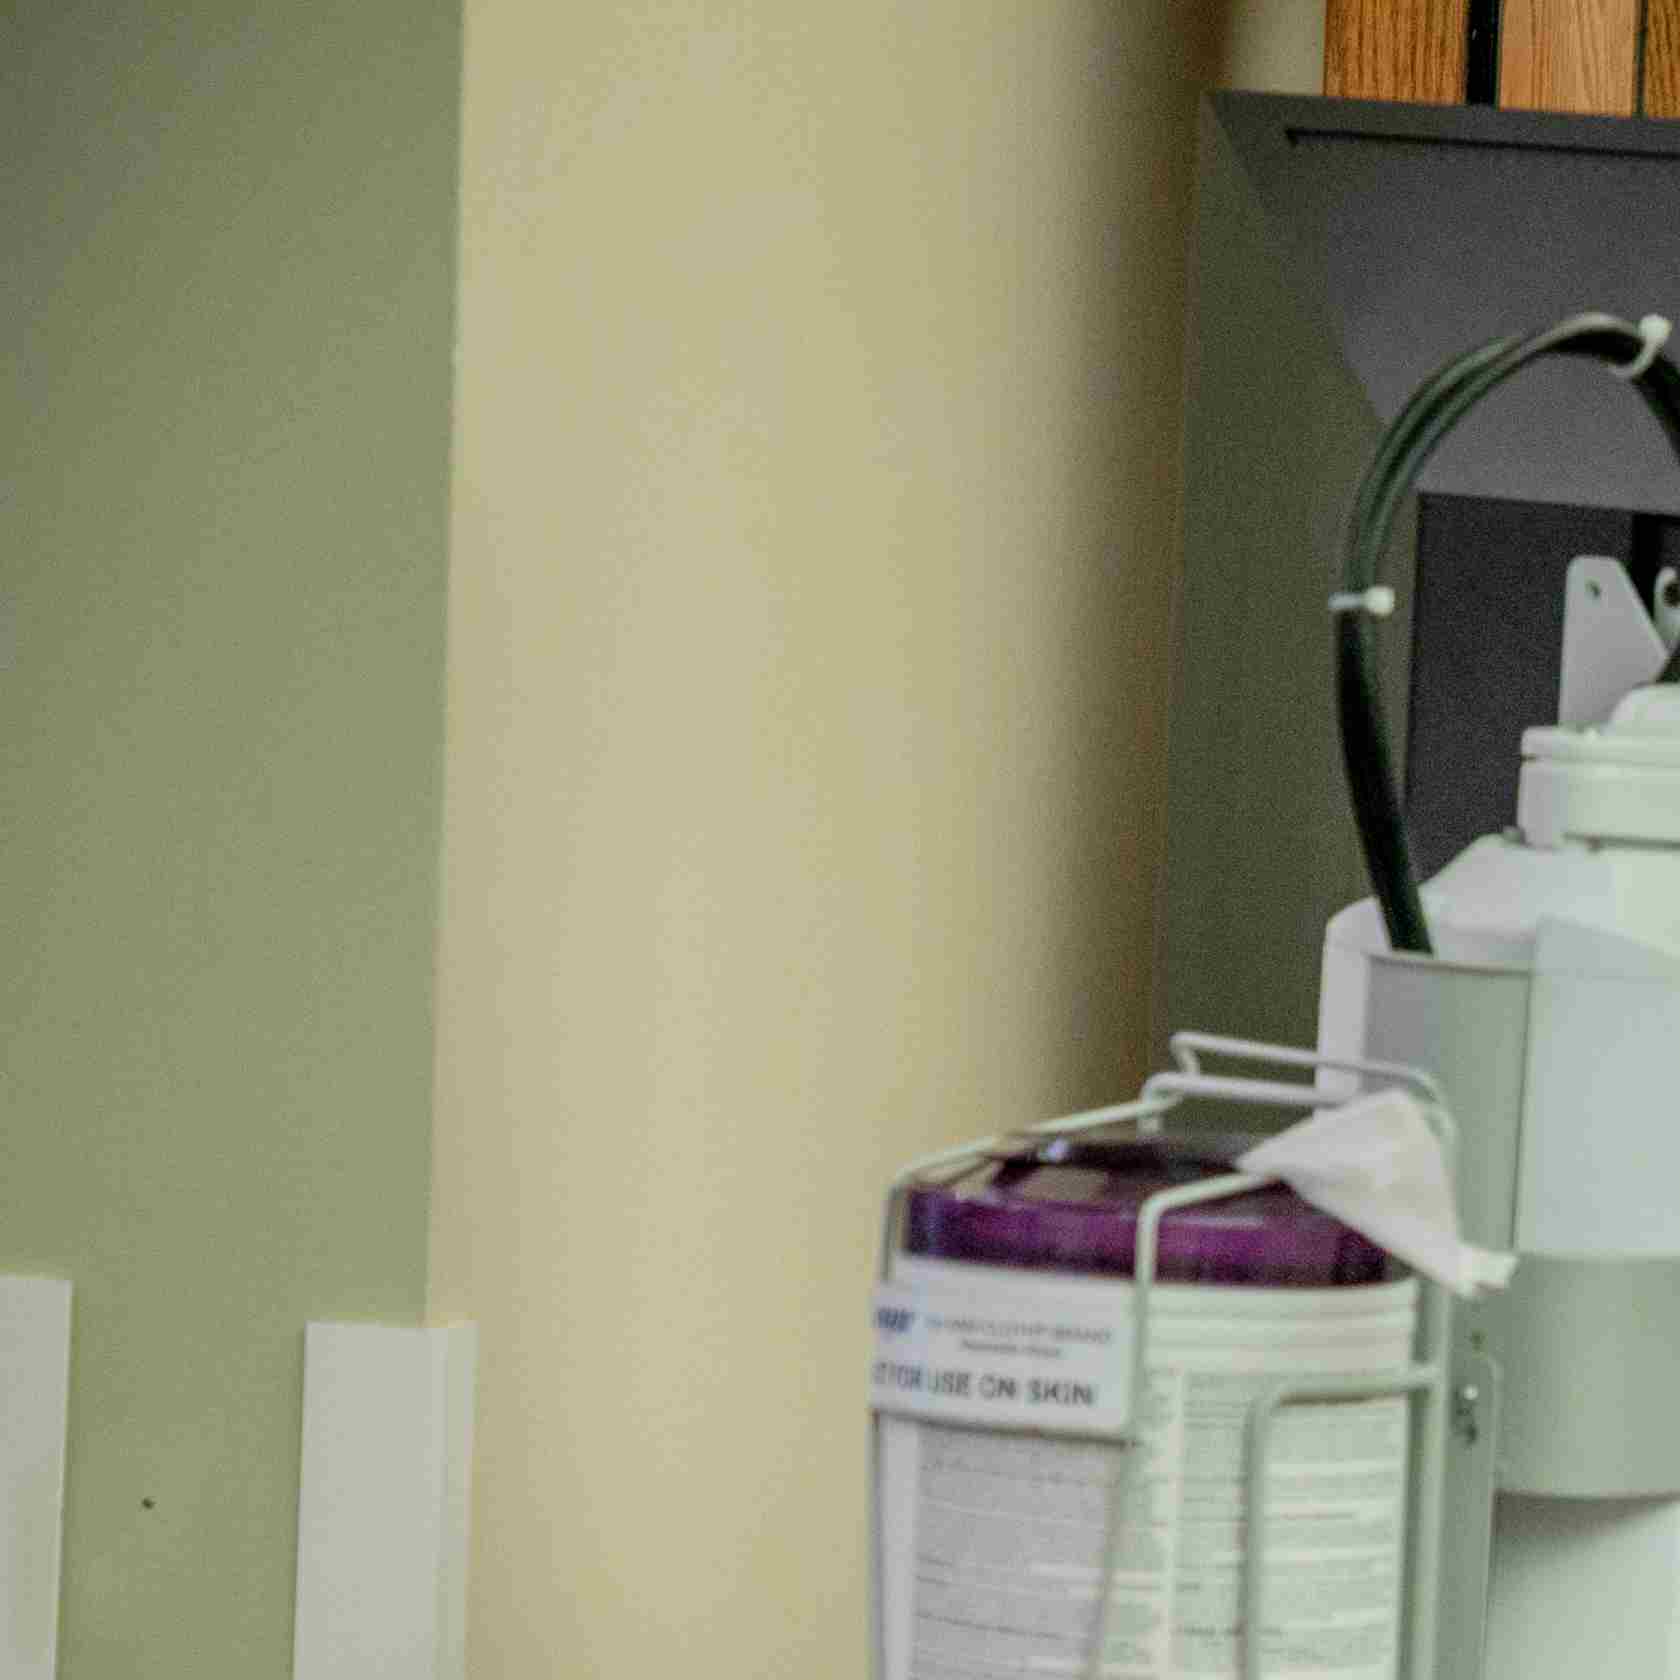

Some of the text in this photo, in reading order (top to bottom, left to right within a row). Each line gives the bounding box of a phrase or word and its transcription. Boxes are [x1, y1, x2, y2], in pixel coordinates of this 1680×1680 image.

[928, 1370, 969, 1399] USE
[979, 1373, 1016, 1399] ON
[1028, 1376, 1097, 1407] SKIN
